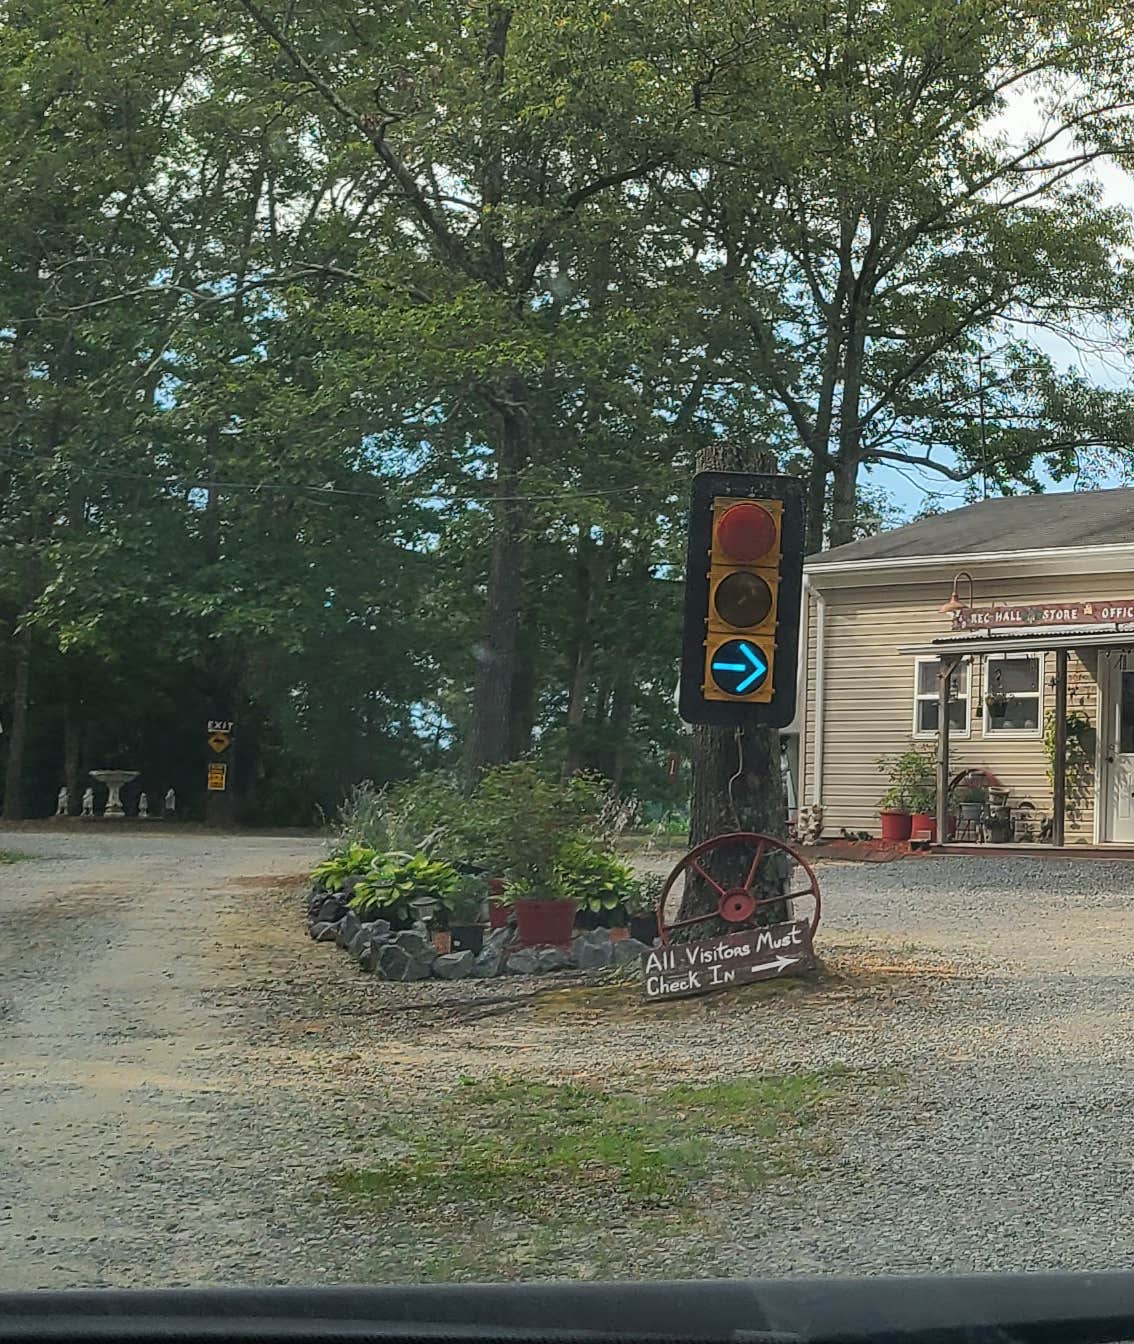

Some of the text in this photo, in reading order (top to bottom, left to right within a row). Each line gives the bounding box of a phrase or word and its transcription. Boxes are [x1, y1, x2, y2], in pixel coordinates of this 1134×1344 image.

[995, 610, 1022, 622] HALL
[1042, 609, 1078, 620] STORE
[208, 720, 234, 730] EXIT
[645, 925, 802, 974] All Visitors Must
[646, 970, 701, 996] Check
